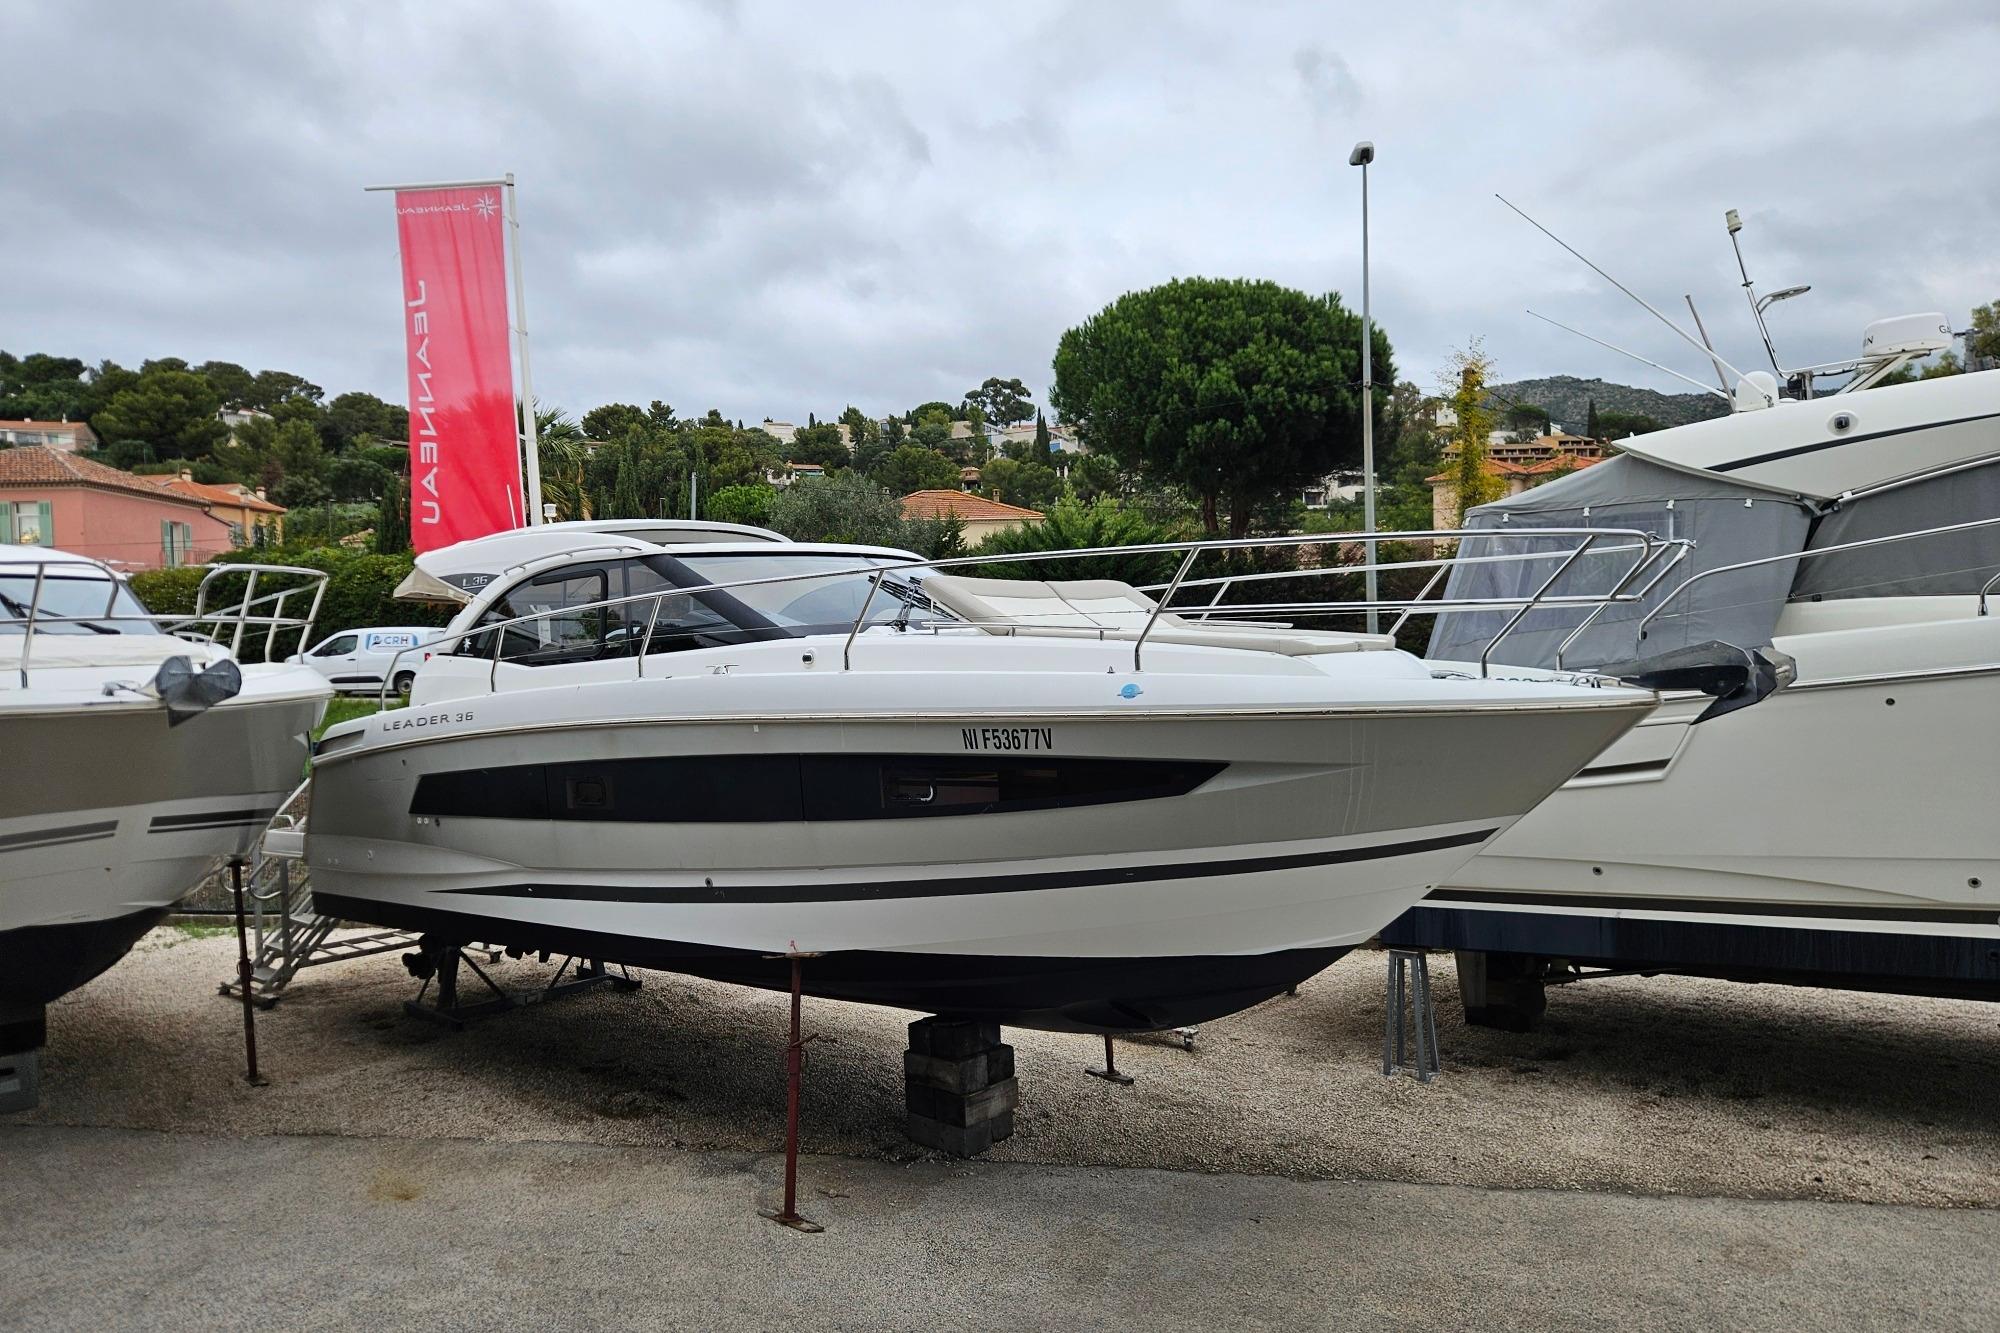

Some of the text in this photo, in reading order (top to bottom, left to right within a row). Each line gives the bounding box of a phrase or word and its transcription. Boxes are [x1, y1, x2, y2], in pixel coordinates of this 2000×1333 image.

[472, 575, 488, 586] 36
[383, 636, 408, 645] CRH
[383, 711, 474, 731] LEADER 36
[961, 727, 1052, 750] NI F53677V
